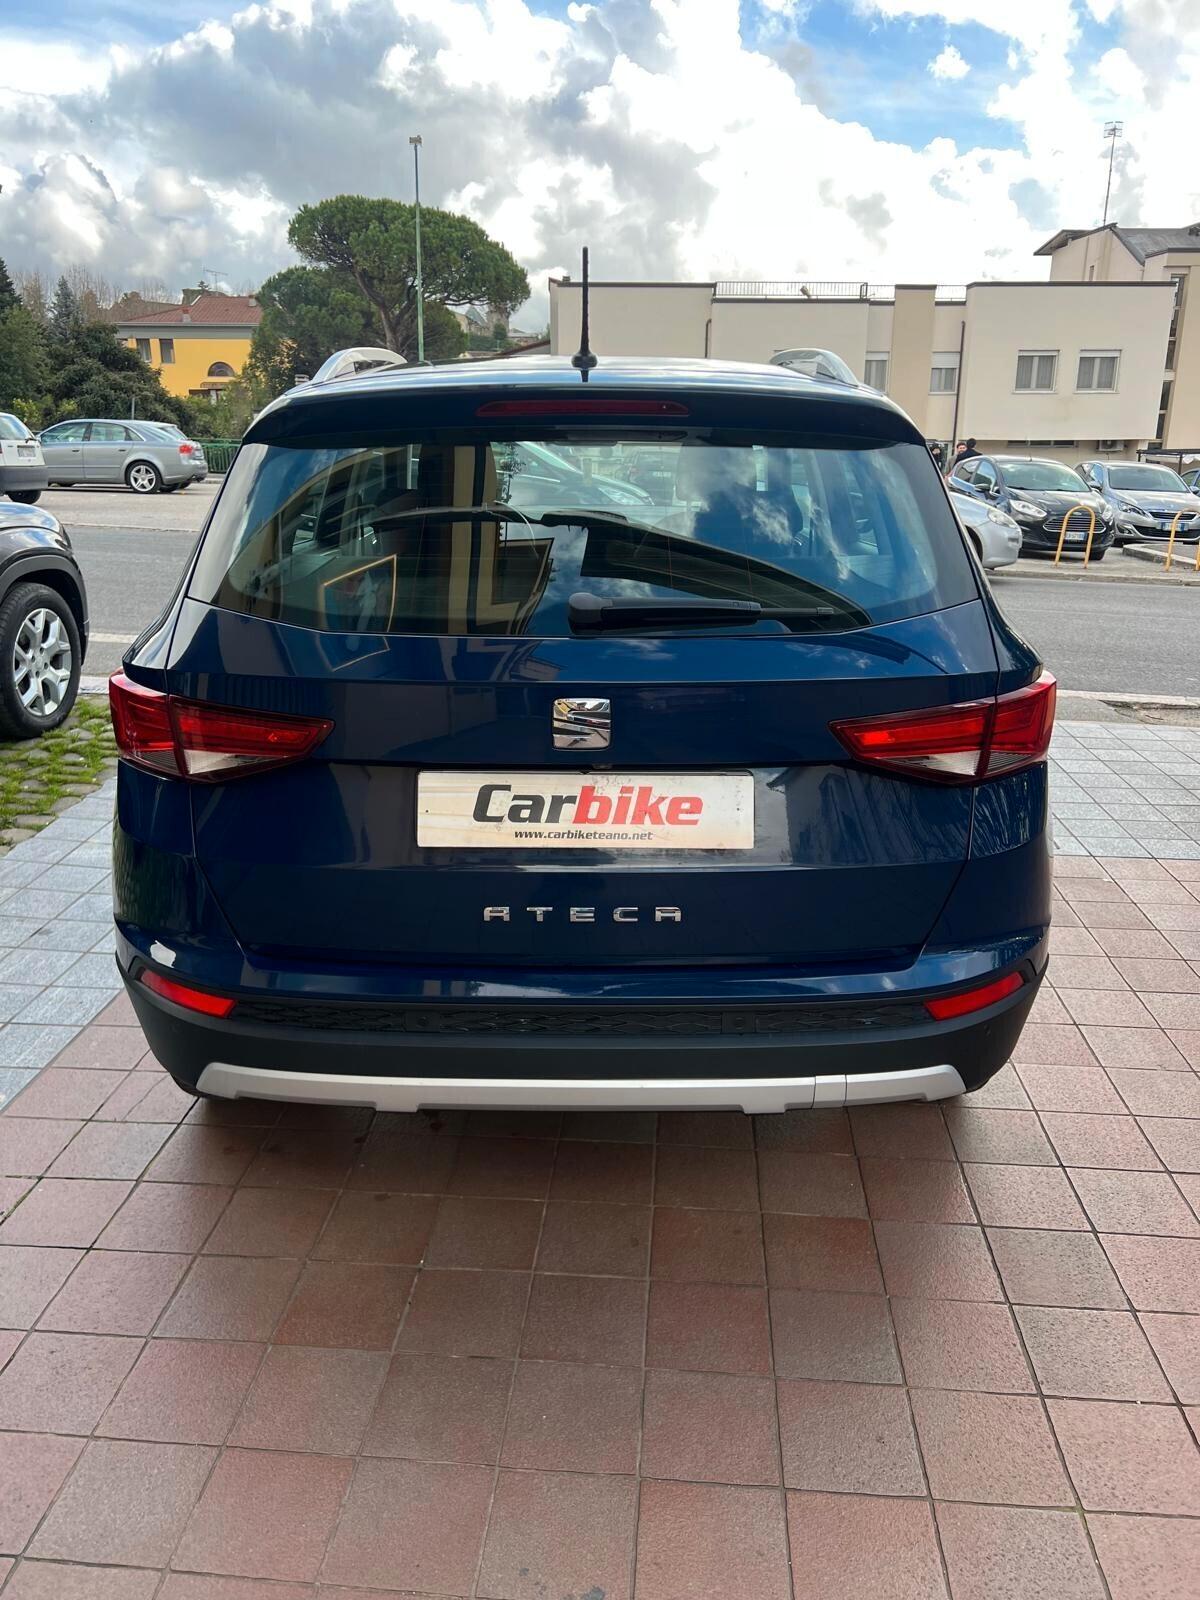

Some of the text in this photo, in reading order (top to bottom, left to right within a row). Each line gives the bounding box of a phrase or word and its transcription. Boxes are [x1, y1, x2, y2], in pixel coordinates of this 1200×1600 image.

[473, 784, 703, 826] Carbike
[514, 829, 654, 841] www.carbiketeano.net
[483, 906, 682, 922] ATECA
